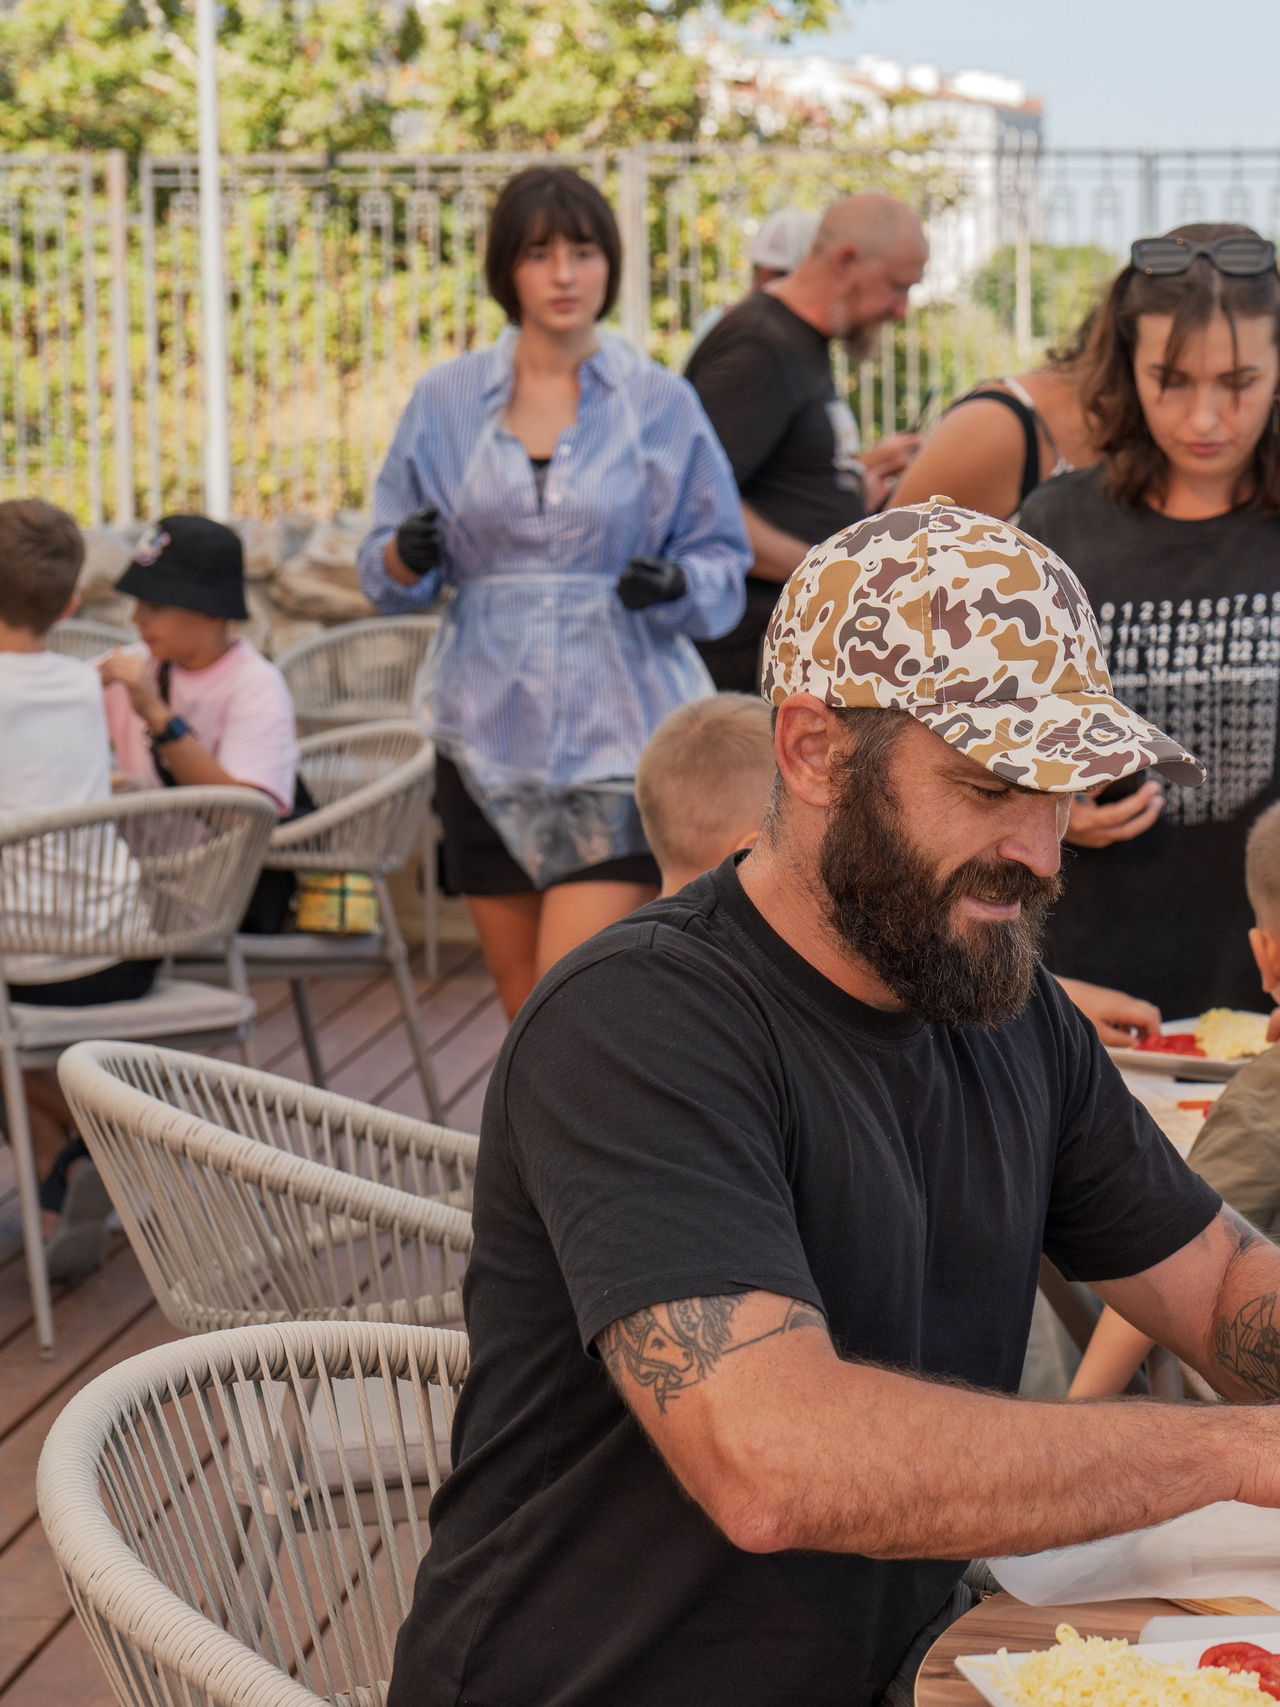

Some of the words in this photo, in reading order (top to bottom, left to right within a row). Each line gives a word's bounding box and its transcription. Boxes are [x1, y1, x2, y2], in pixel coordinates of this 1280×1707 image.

[1101, 602, 1115, 621] 0
[1121, 601, 1133, 620] 1
[1139, 601, 1154, 620] 2
[1158, 600, 1173, 619] 3
[1177, 599, 1193, 617] 4
[1198, 598, 1212, 618] 5
[1216, 597, 1230, 616] 6
[1234, 593, 1248, 613] 7
[1252, 593, 1267, 613] 8
[1100, 625, 1113, 645] 0
[1117, 624, 1140, 644] 11
[1149, 623, 1171, 643] 12
[1176, 622, 1199, 642] 13
[1204, 620, 1226, 640] 14
[1231, 617, 1254, 638] 15
[1145, 647, 1169, 667] 19
[1173, 646, 1198, 666] 20
[1202, 643, 1223, 664] 21
[1228, 640, 1253, 661] 22
